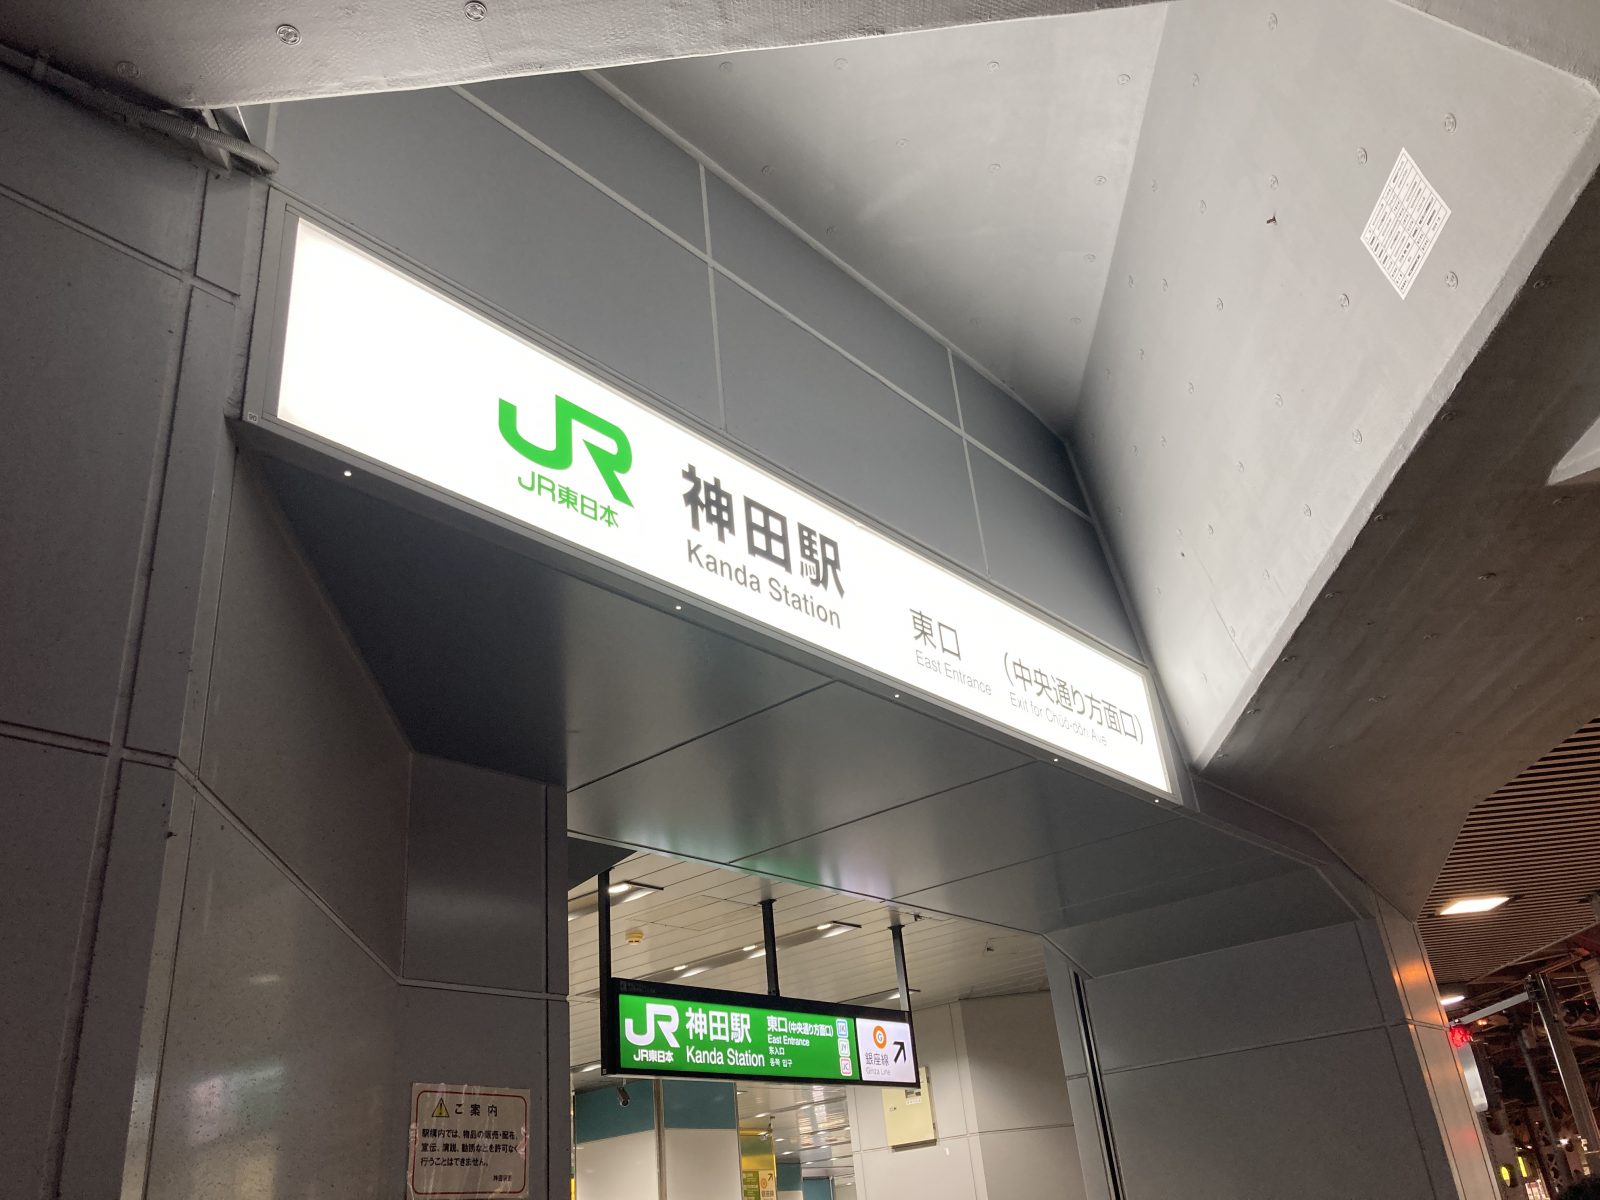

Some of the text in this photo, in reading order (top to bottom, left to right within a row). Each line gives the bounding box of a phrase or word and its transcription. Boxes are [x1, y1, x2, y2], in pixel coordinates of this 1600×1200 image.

[498, 394, 635, 508] JR
[517, 471, 619, 527] JR東日本
[681, 463, 845, 598] 神田駅
[687, 539, 842, 629] Kanda Station
[909, 608, 962, 661] 東口
[915, 649, 993, 696] East Entrance
[1010, 692, 1029, 712] Exit
[624, 1003, 680, 1048] JR
[685, 1007, 752, 1044] 神田駅
[766, 1015, 788, 1033] 東口
[767, 1034, 810, 1047] East Entrance
[633, 1049, 674, 1063] JR東日本
[686, 1045, 765, 1067] Kanda Station
[865, 1052, 890, 1067] 銀座線
